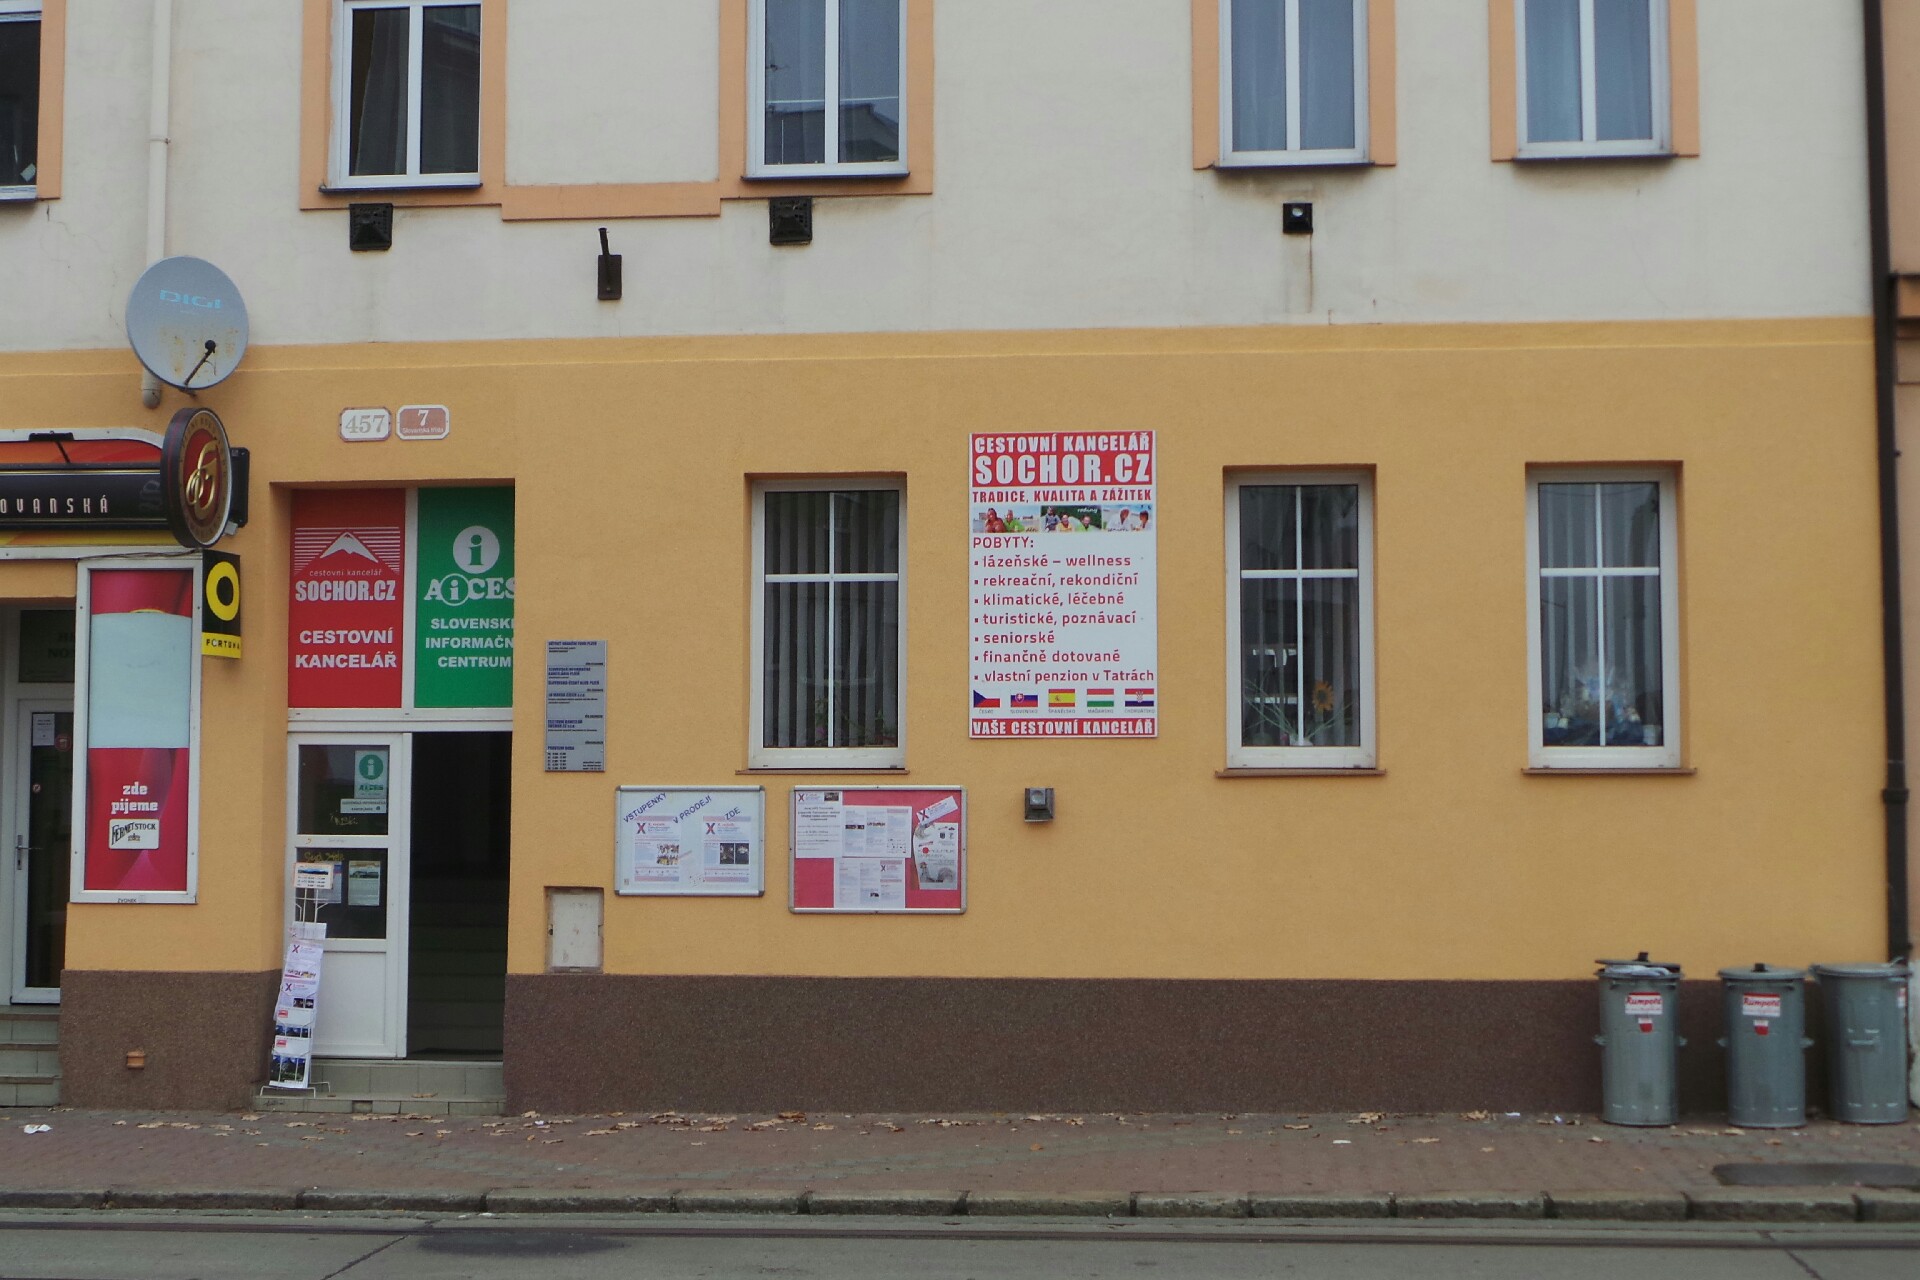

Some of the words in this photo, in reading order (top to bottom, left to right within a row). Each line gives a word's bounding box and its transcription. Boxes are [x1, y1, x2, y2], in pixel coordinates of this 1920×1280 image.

[159, 289, 224, 309] DIGI
[345, 414, 386, 434] 457
[417, 409, 430, 427] 7
[974, 433, 1057, 454] CESTOVNÍ
[1063, 432, 1150, 452] KANCELÁŘ
[975, 453, 1150, 485] SOCHOR.CZ
[972, 490, 1030, 503] TRADICE,
[1034, 489, 1085, 502] KVALITA
[1090, 489, 1098, 501] A
[1102, 486, 1152, 501] ZÁŽITEK
[973, 536, 1035, 548] POBYTY:
[983, 554, 1048, 567] lázeňské
[1065, 555, 1131, 566] wellness
[309, 568, 344, 577] cestovní
[346, 567, 383, 577] kancelář
[983, 573, 1056, 587] rekreační,
[1060, 572, 1138, 586] rekondiční
[295, 580, 396, 602] SOCHOR.CZ
[983, 592, 1063, 606] klimatické,
[1068, 592, 1124, 605] léčebné
[430, 618, 514, 629] SLOVENSK
[983, 611, 1057, 625] turistické,
[1062, 610, 1137, 627] poznávací
[206, 638, 240, 650] FORTUNA
[299, 627, 394, 645] CESTOVNÍ
[983, 630, 1055, 644] seniorské
[295, 651, 397, 668] KANCELÁŘ
[438, 656, 512, 668] CENTRUM
[983, 649, 1047, 663] finančně
[1052, 649, 1121, 662] dotované
[984, 669, 1031, 682] vlastní
[1035, 670, 1088, 684] penzion
[1092, 671, 1100, 681] v
[1103, 668, 1154, 681] Tatrách
[972, 720, 1006, 735] VAŠE
[1011, 719, 1079, 735] CESTOVNÍ
[1083, 719, 1153, 734] KANCELÁŘ
[122, 781, 148, 795] zde
[111, 798, 158, 815] pijeme
[623, 792, 667, 823] VSTUPENKY
[725, 806, 741, 821] ZDE
[111, 822, 135, 846] FERNET
[135, 823, 157, 831] STOCK
